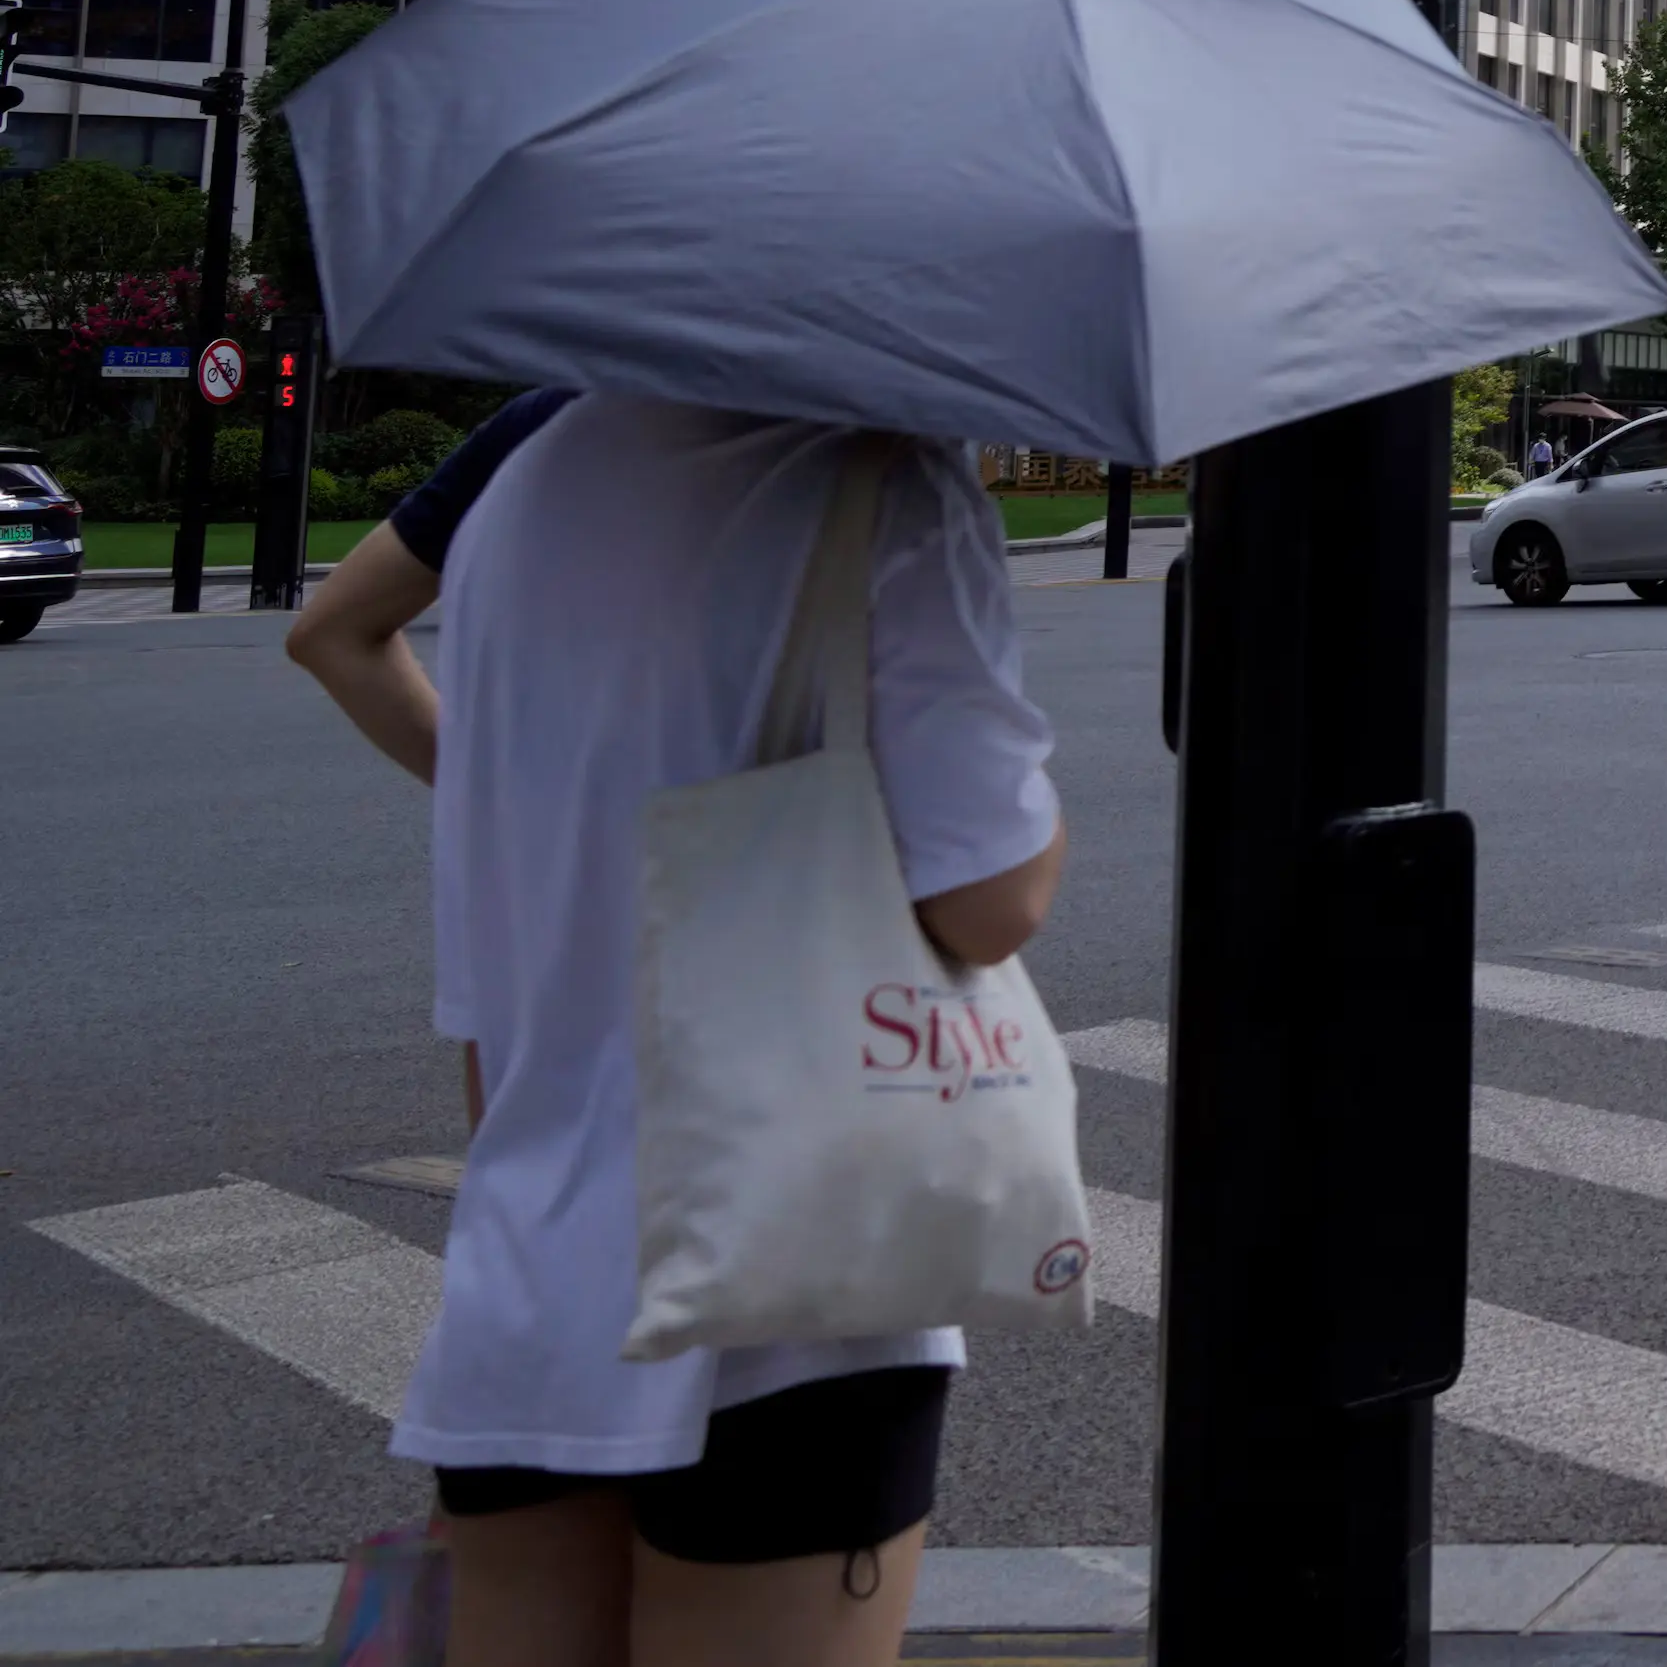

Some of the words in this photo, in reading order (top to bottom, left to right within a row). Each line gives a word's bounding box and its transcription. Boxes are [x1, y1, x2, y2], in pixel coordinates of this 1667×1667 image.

[122, 350, 173, 365] 石门二路
[282, 385, 296, 407] 5
[861, 981, 1025, 1103] Style
